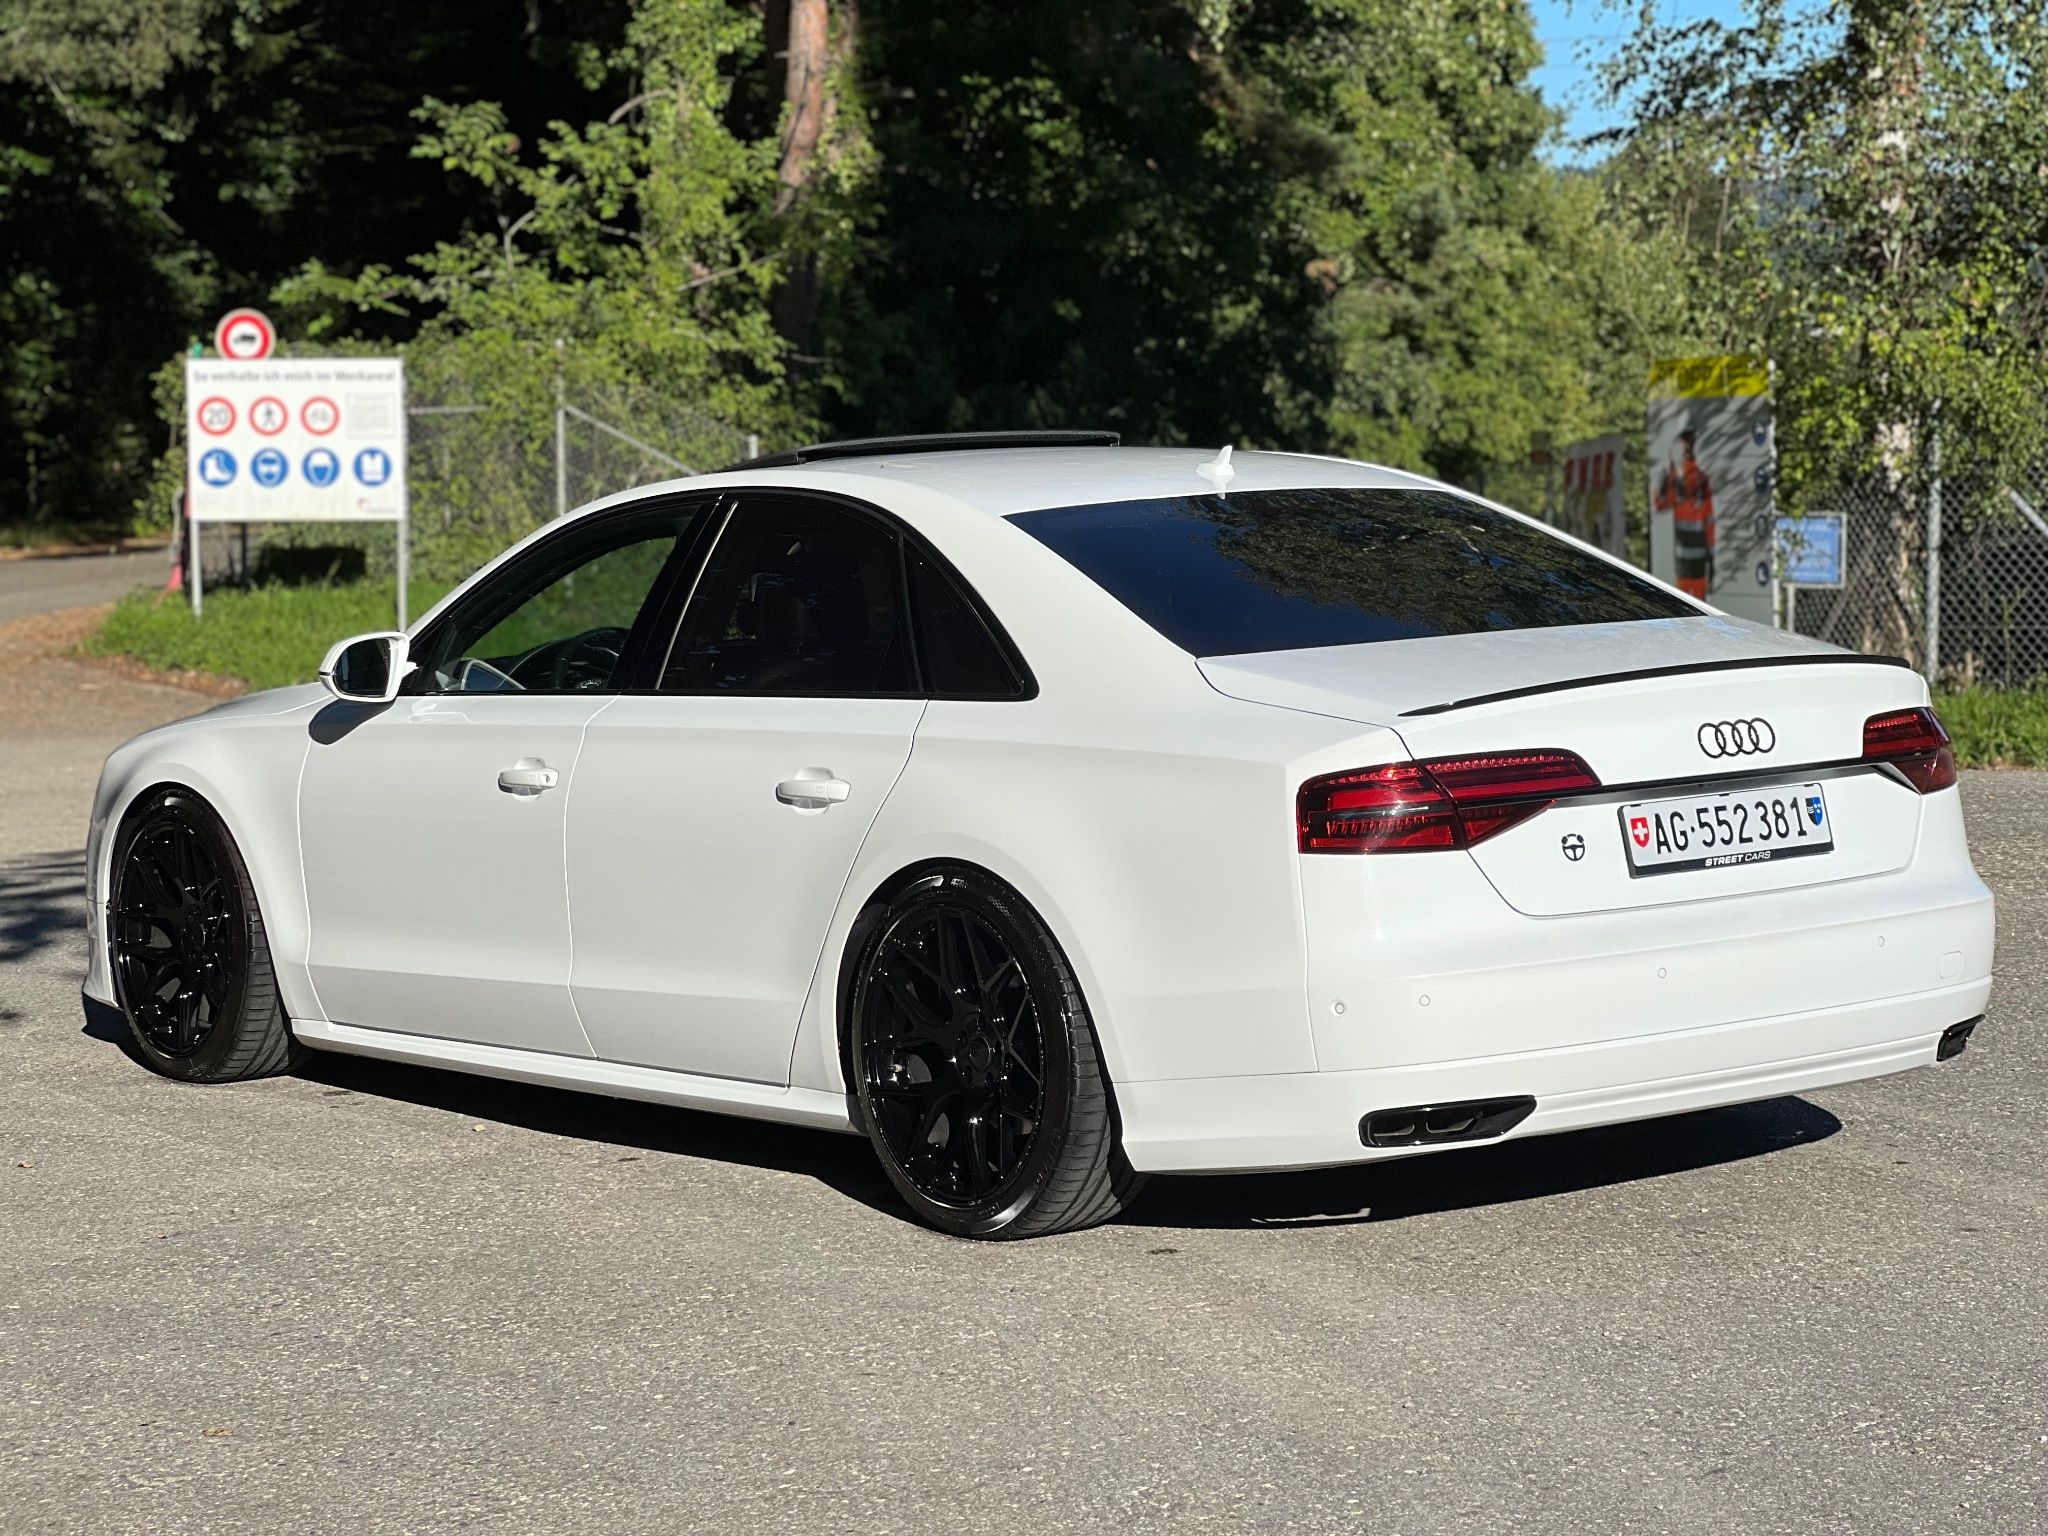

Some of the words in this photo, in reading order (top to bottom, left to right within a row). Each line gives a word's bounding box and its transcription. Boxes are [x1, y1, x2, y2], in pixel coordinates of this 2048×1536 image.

[207, 407, 230, 427] 20
[1705, 853, 1744, 867] STREET
[1744, 851, 1771, 863] CARS
